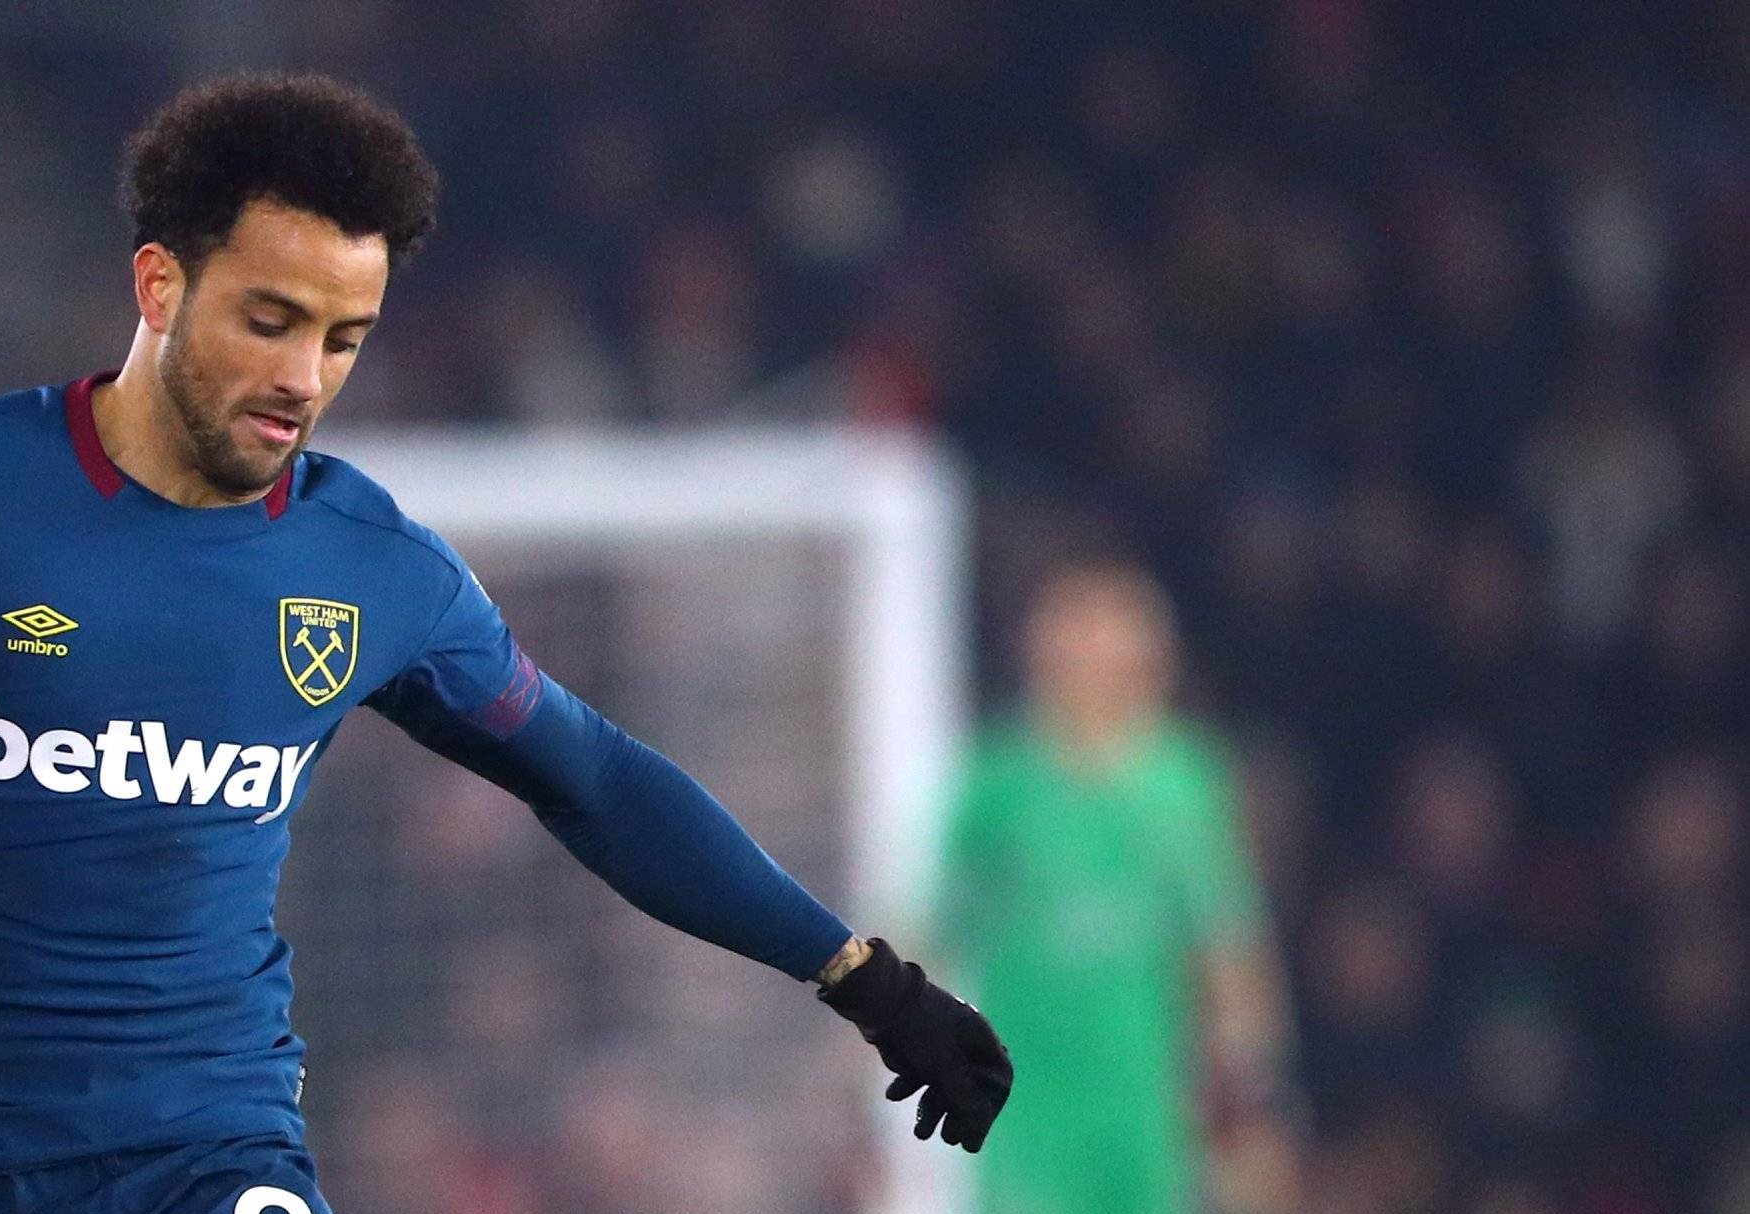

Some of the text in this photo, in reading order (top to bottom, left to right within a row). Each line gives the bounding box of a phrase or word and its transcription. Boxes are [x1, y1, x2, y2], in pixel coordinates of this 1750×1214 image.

[289, 604, 349, 623] WEST HAM
[302, 615, 337, 629] UNITED
[7, 638, 69, 656] umbro
